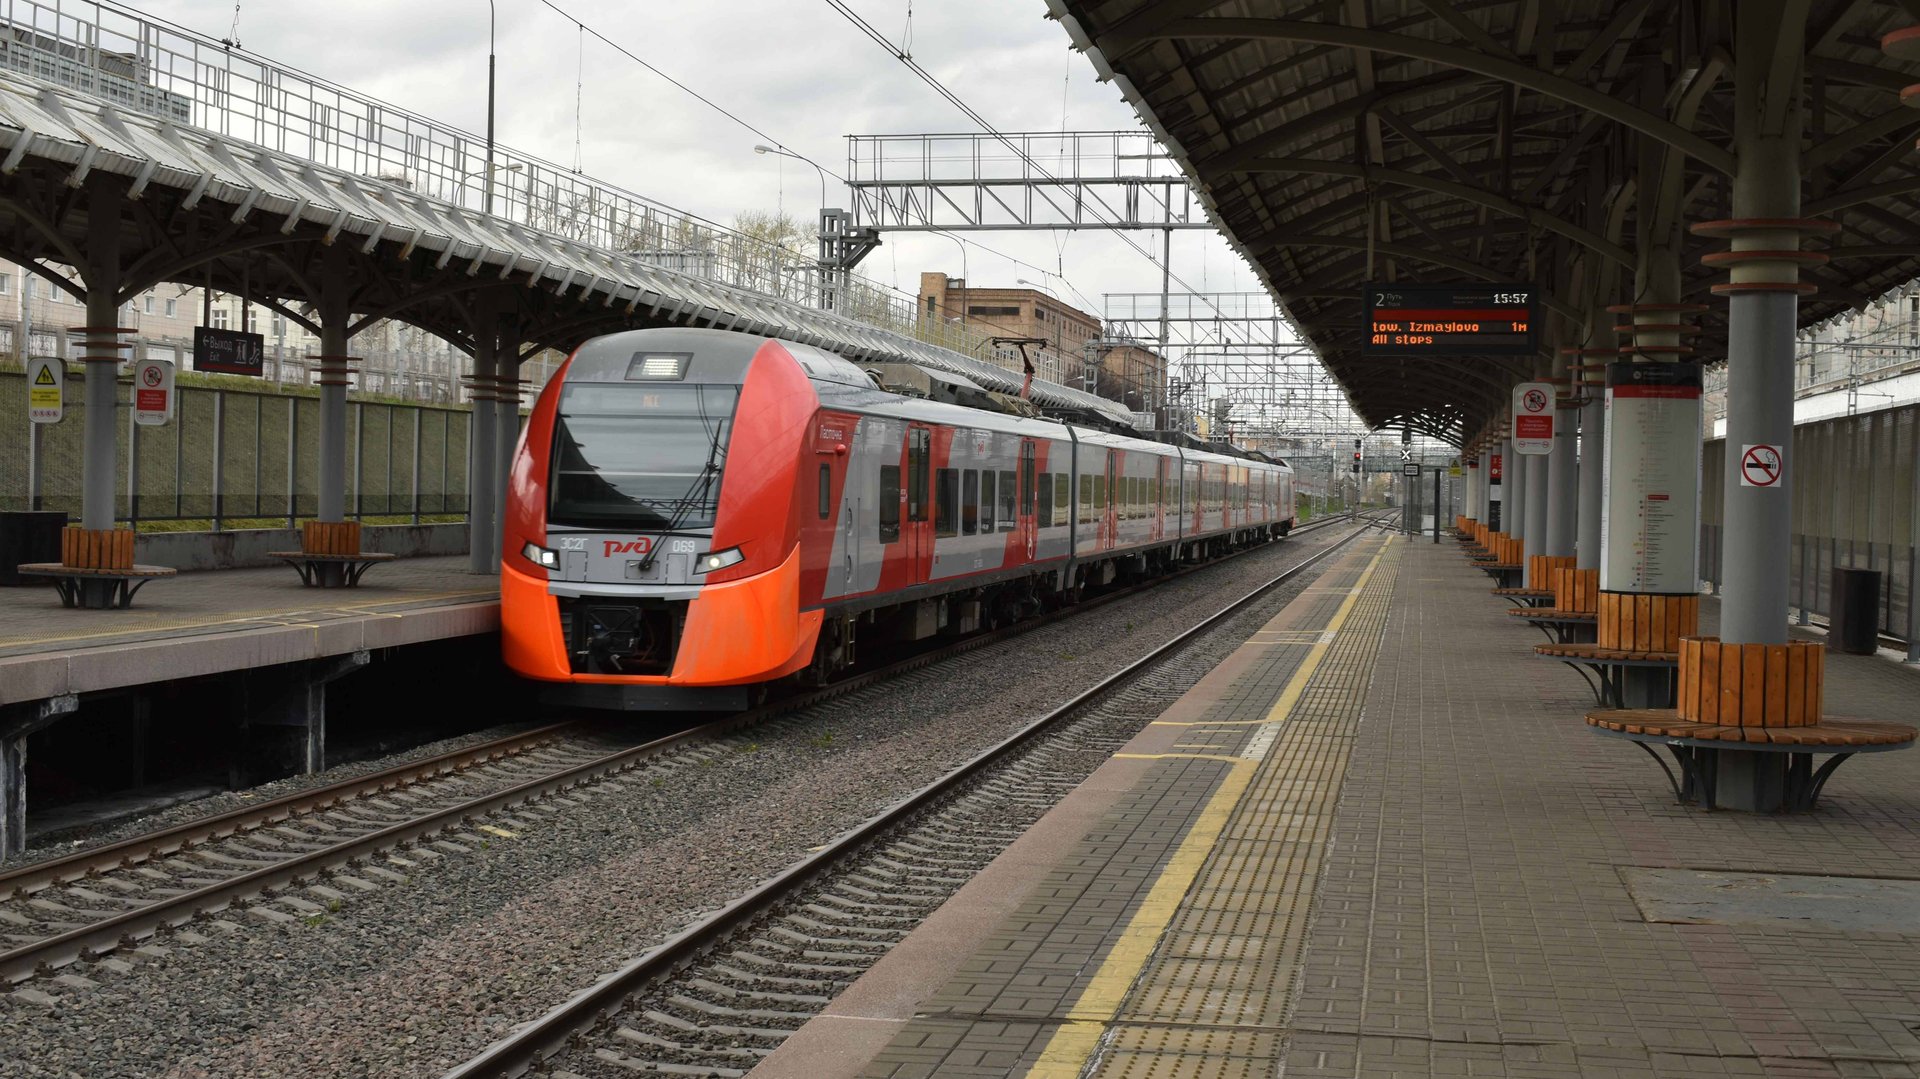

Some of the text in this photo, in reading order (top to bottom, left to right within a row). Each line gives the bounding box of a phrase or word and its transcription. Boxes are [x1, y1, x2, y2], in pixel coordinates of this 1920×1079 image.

[1375, 293, 1385, 307] 2
[1387, 293, 1402, 301] Путь
[1493, 293, 1528, 304] 15:57
[1373, 322, 1402, 332] tow.
[1409, 322, 1479, 333] Izmaylovo
[209, 336, 233, 352] Выход
[1372, 334, 1433, 344] All stops
[209, 352, 220, 362] Exit
[820, 424, 843, 440] Ласточка
[672, 540, 696, 553] 069
